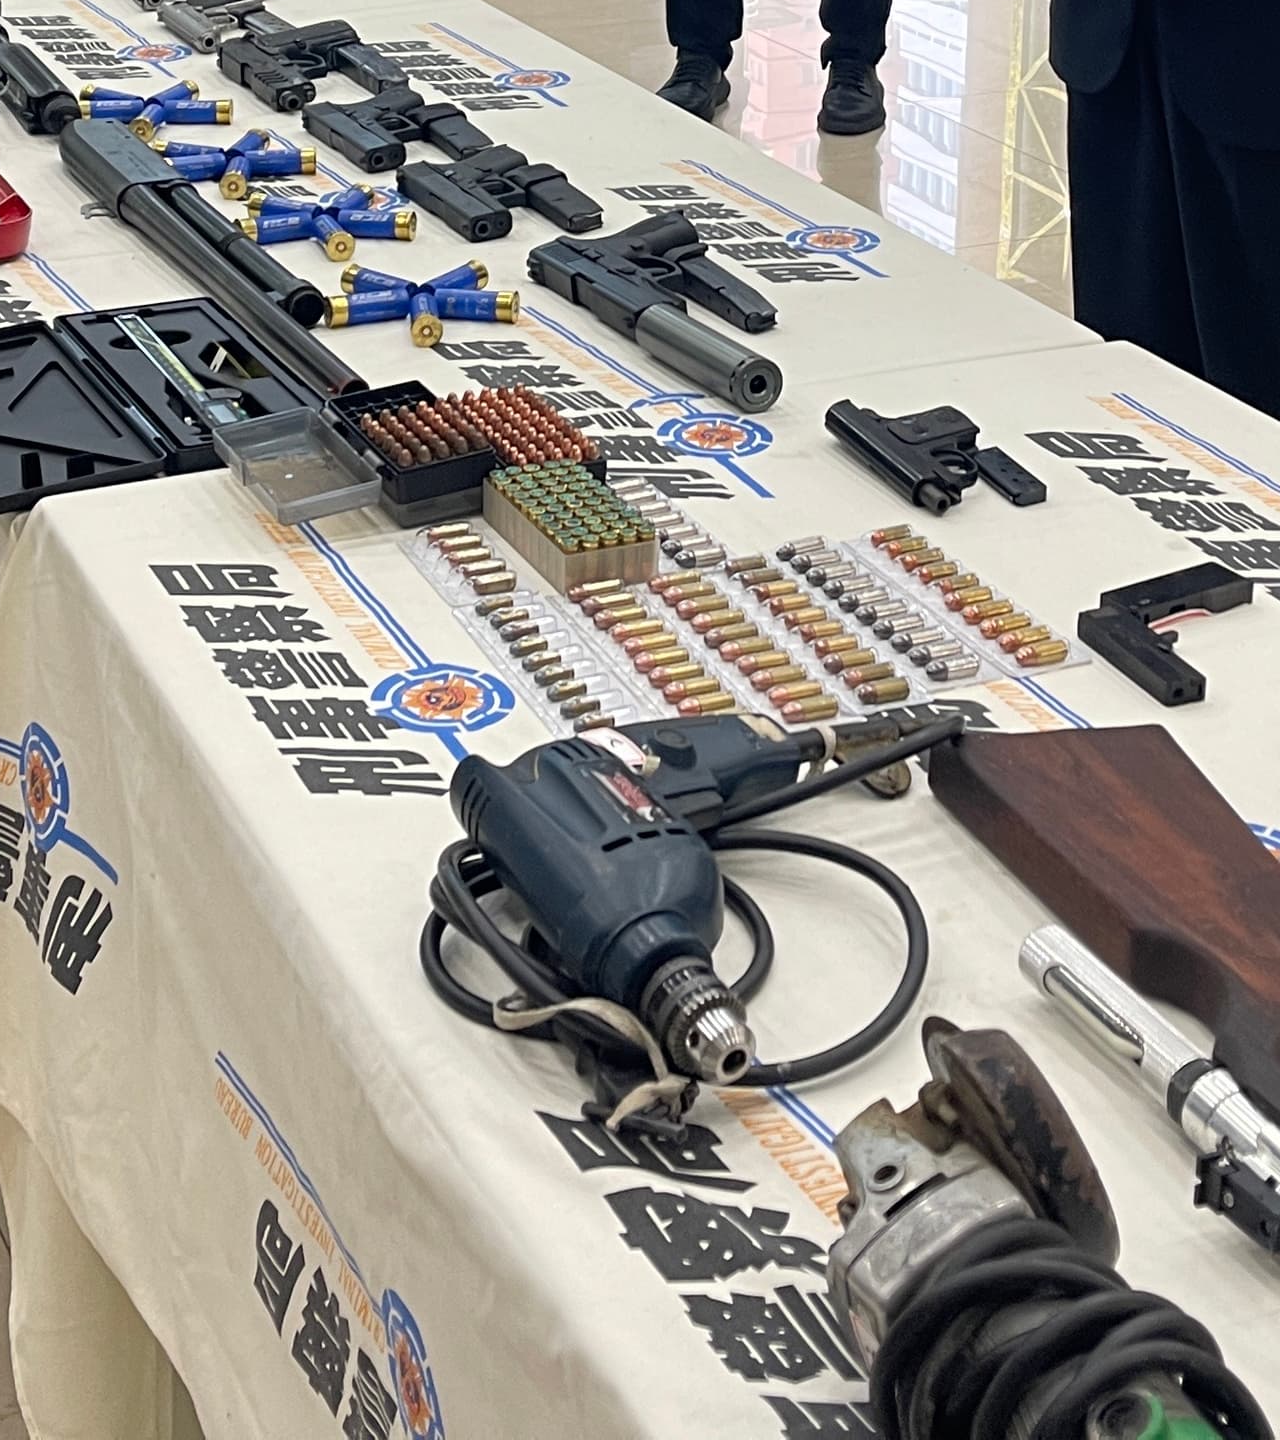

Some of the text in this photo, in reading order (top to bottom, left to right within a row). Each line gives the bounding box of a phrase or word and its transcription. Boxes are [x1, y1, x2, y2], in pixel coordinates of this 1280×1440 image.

[148, 563, 450, 796] 刑事警察局
